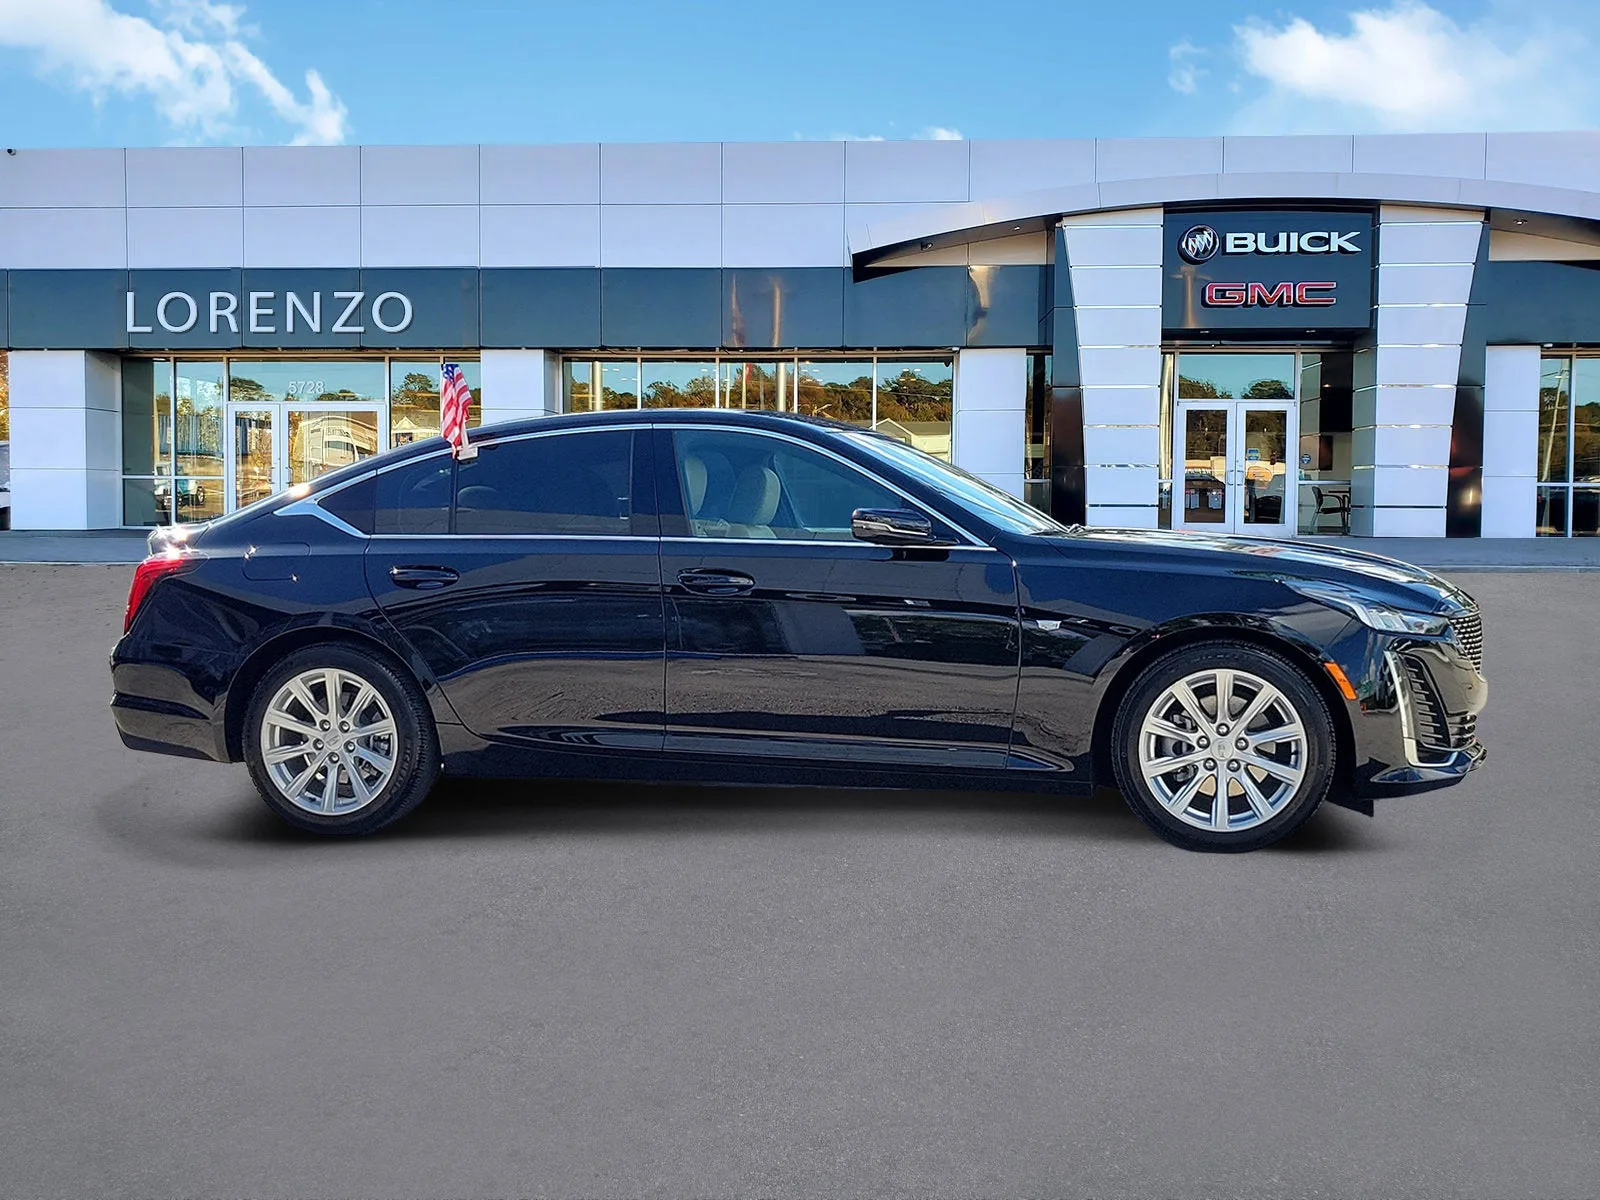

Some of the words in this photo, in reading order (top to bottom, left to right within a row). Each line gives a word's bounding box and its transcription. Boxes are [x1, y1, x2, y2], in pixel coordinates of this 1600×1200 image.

[1225, 232, 1362, 253] BUICK
[1204, 282, 1337, 305] GMC
[126, 291, 414, 333] LORENZO
[288, 380, 325, 394] 5728
